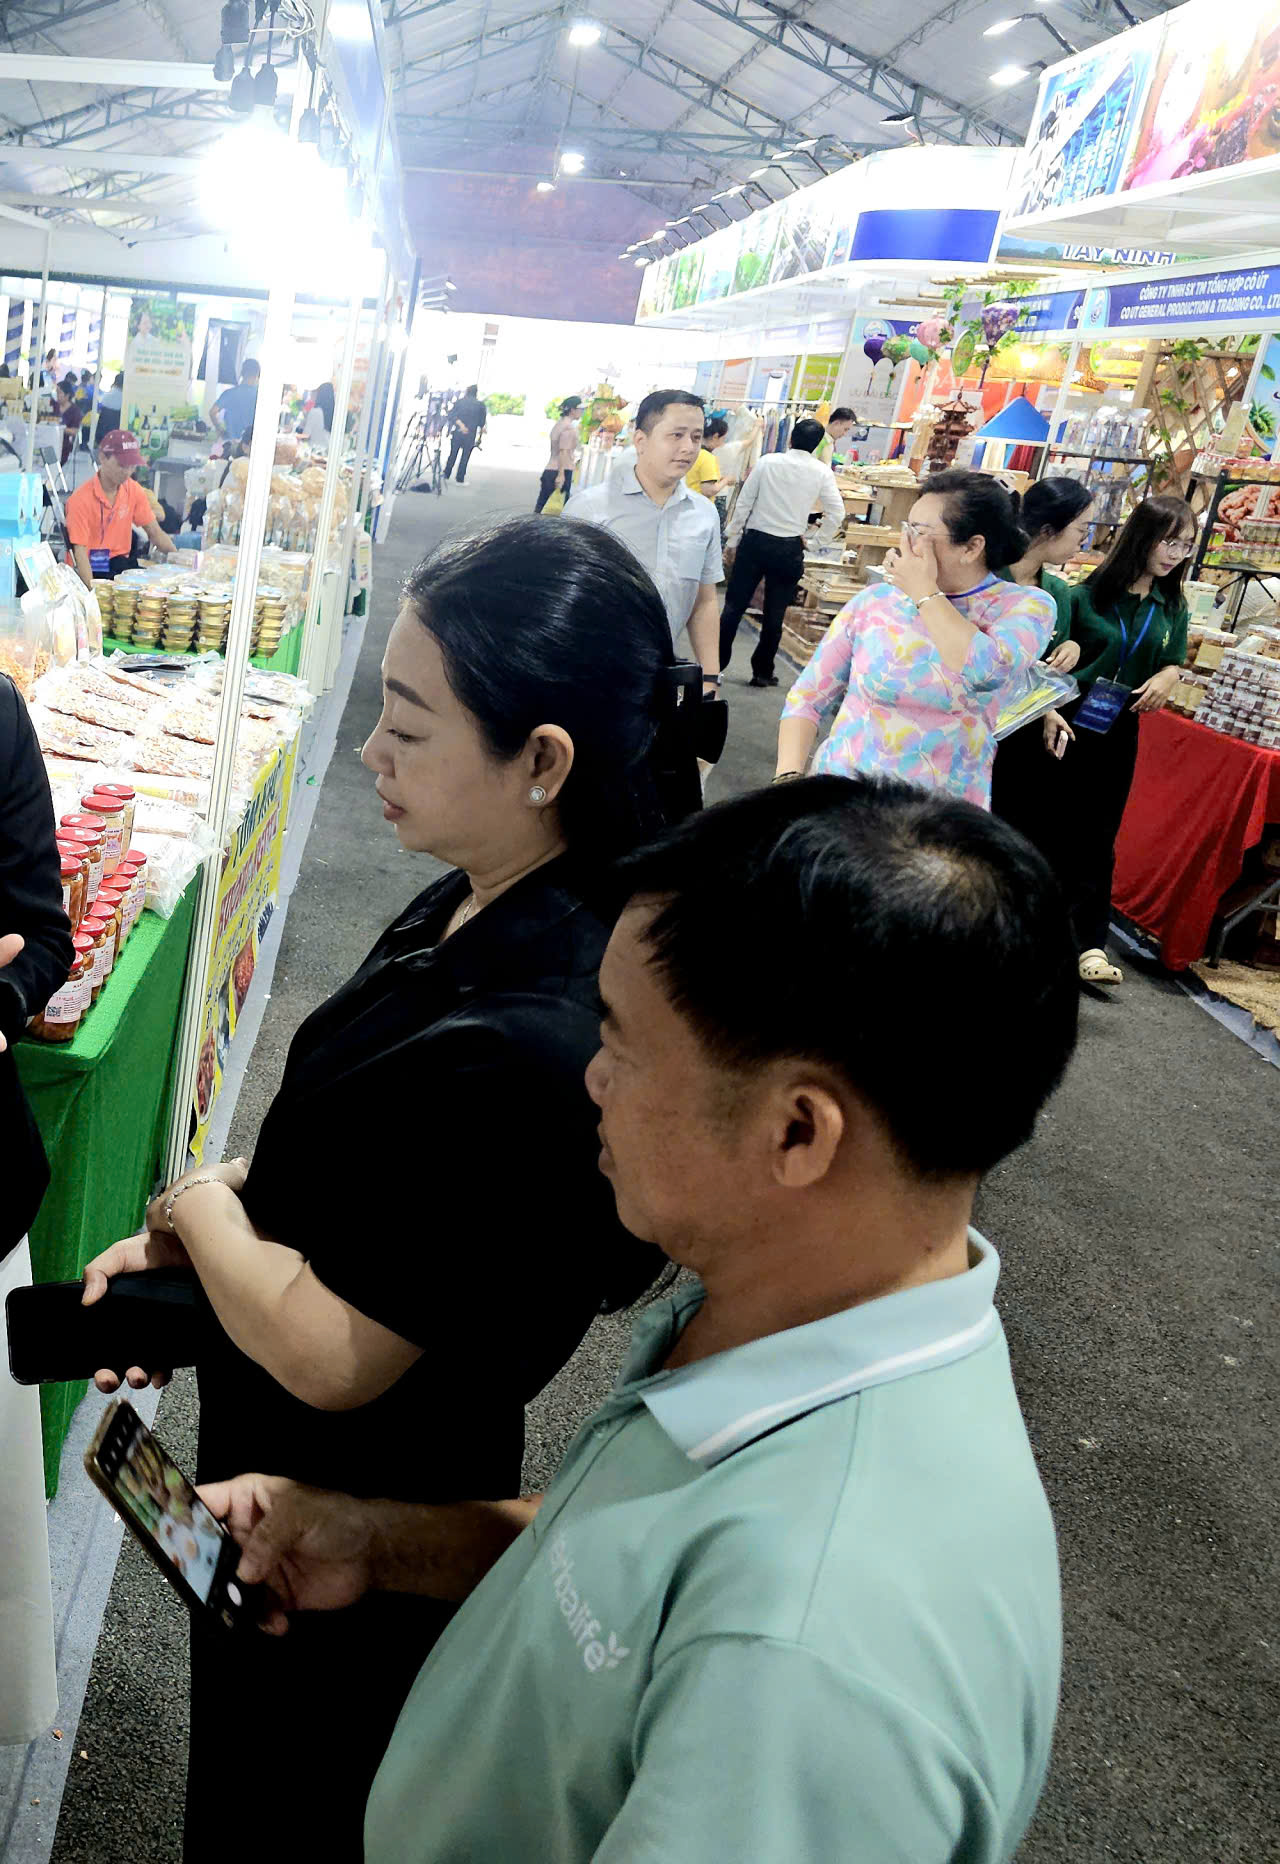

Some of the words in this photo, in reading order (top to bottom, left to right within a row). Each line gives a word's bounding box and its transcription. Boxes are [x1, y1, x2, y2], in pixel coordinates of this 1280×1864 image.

[1139, 283, 1158, 301] CÔNG
[1158, 286, 1168, 299] TY
[1139, 303, 1166, 318] GENERAL
[1167, 300, 1209, 317] PRODUCTION
[1209, 299, 1215, 313] &
[1216, 297, 1249, 312] TRADING
